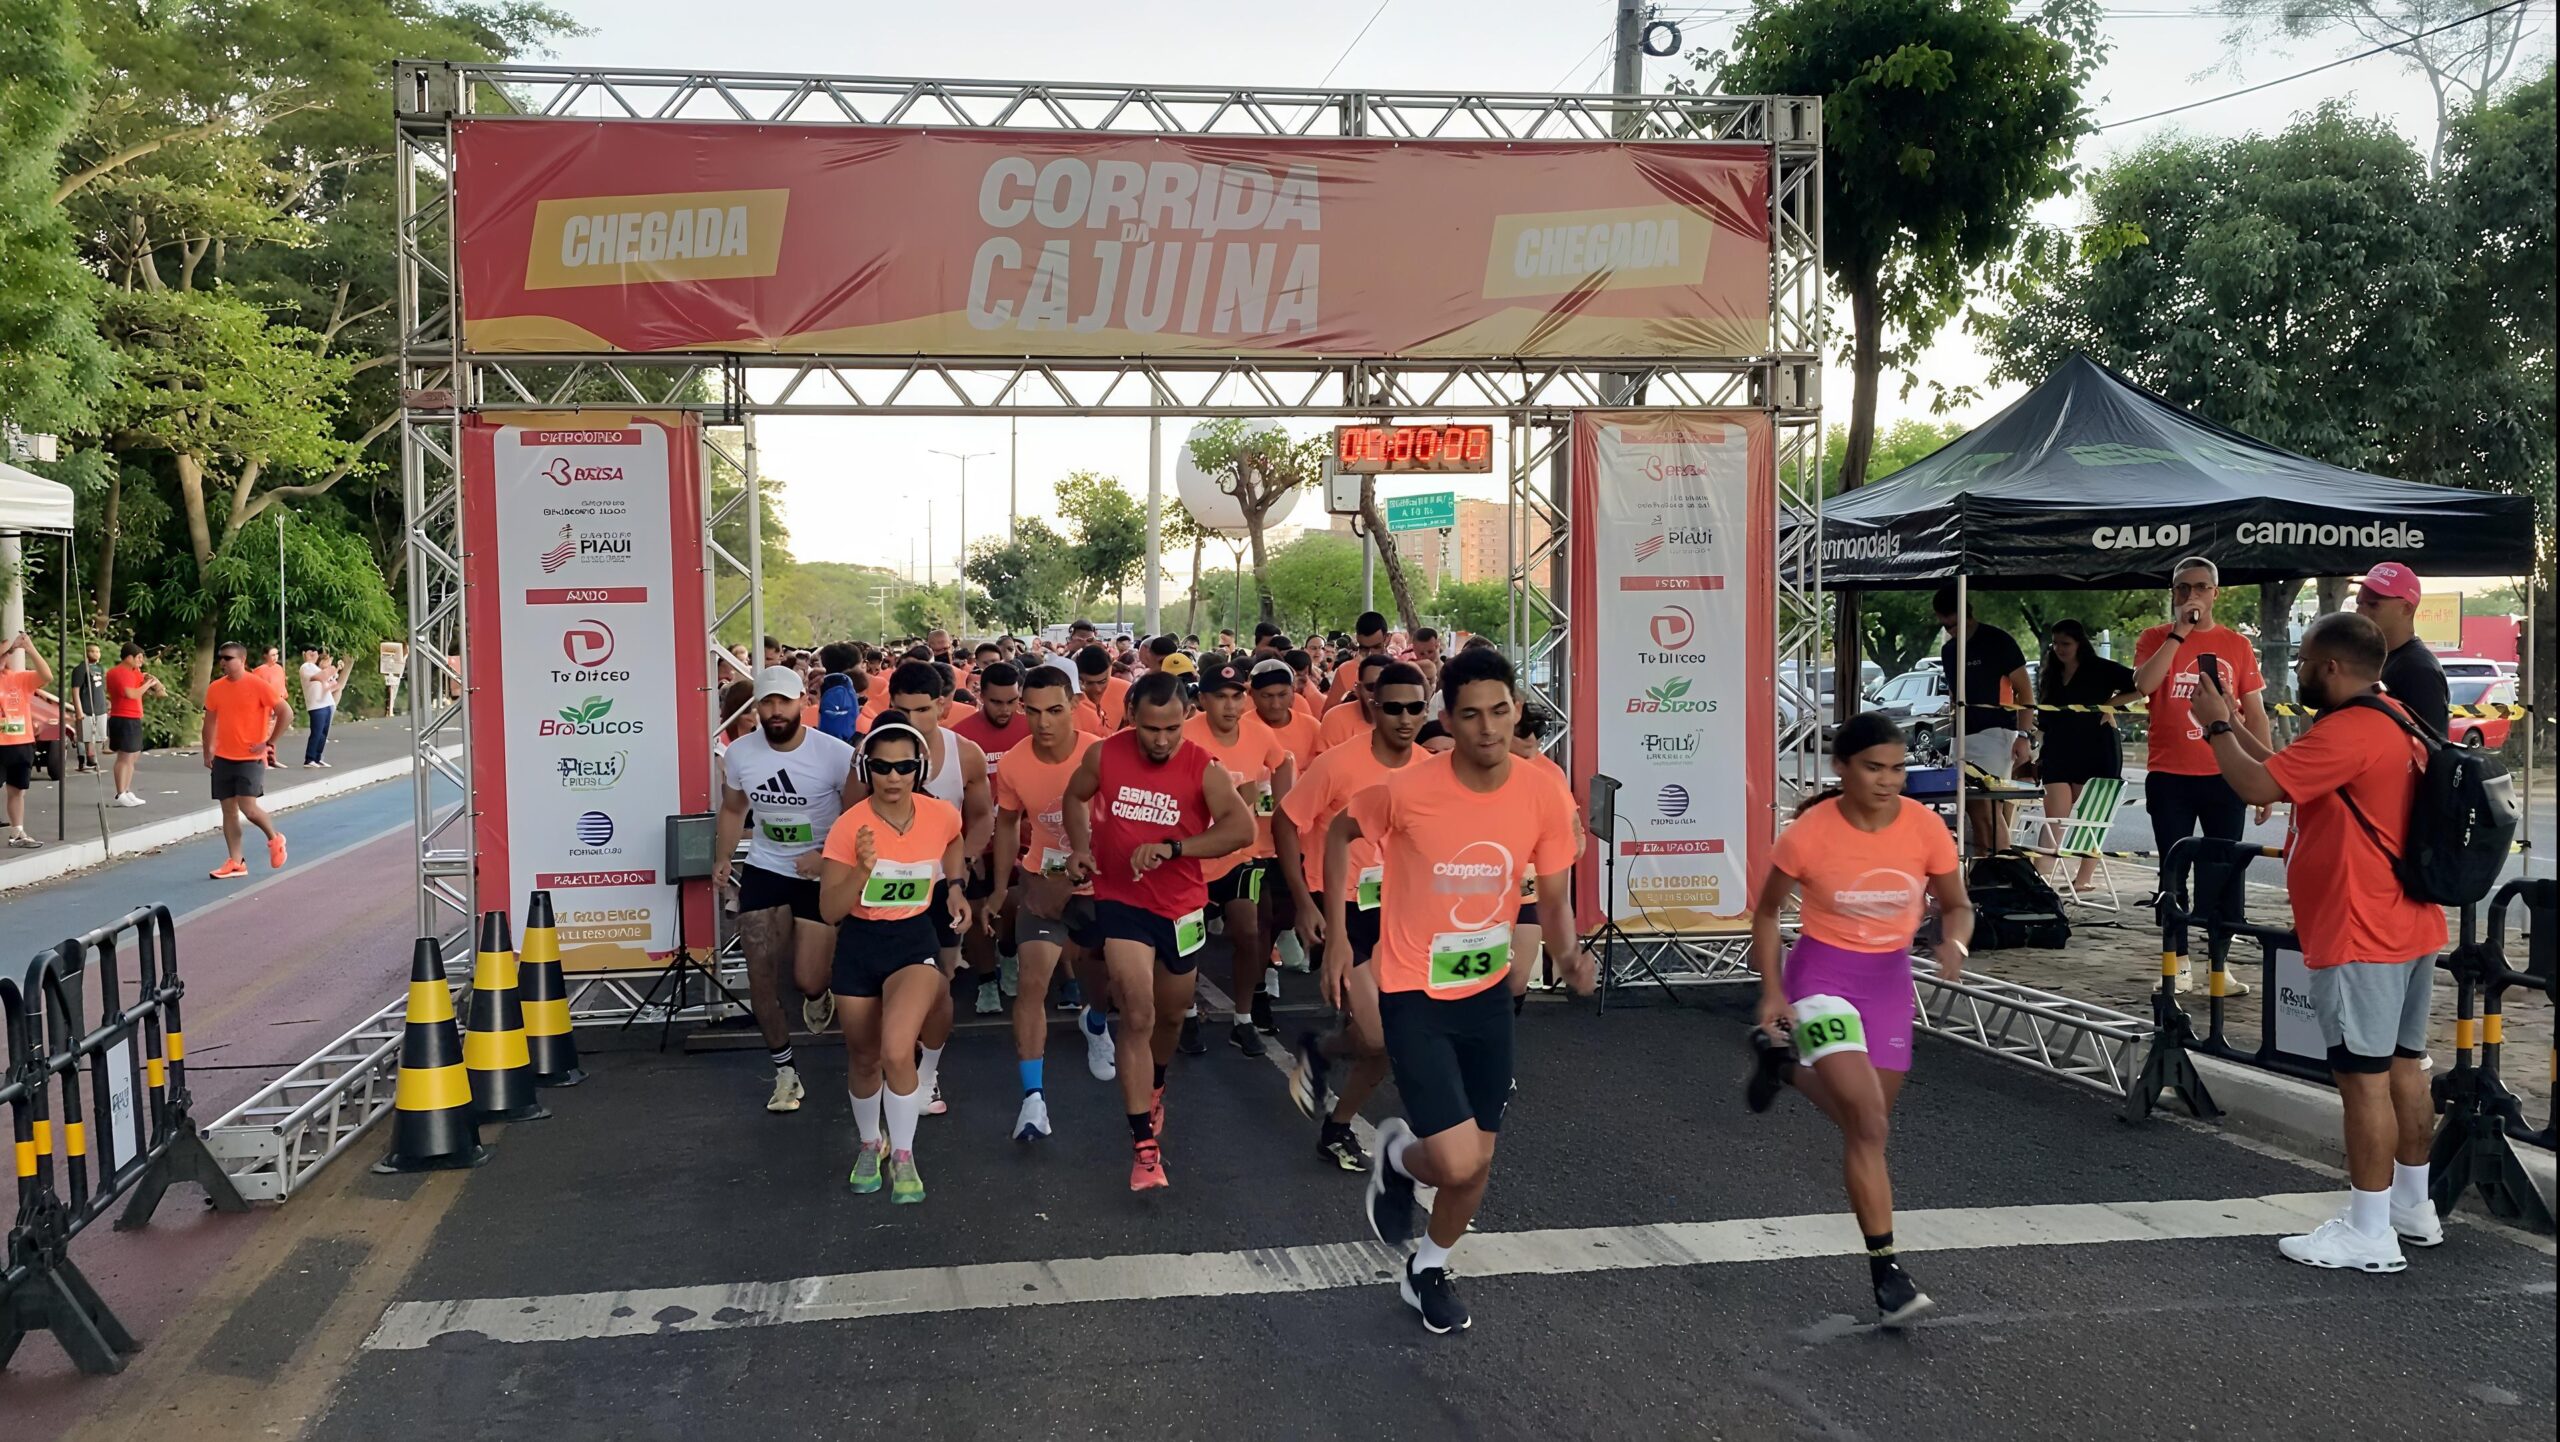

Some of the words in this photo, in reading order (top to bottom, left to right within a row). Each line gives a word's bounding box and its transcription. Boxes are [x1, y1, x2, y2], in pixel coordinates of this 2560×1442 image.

[978, 156, 1321, 239] CORRIDA
[560, 205, 749, 268] CHEGADA
[1513, 219, 1680, 280] CHEGADA
[2091, 524, 2191, 550] CALOI
[2236, 521, 2425, 549] cannondale
[880, 881, 916, 901] 20
[1450, 951, 1493, 979] 43
